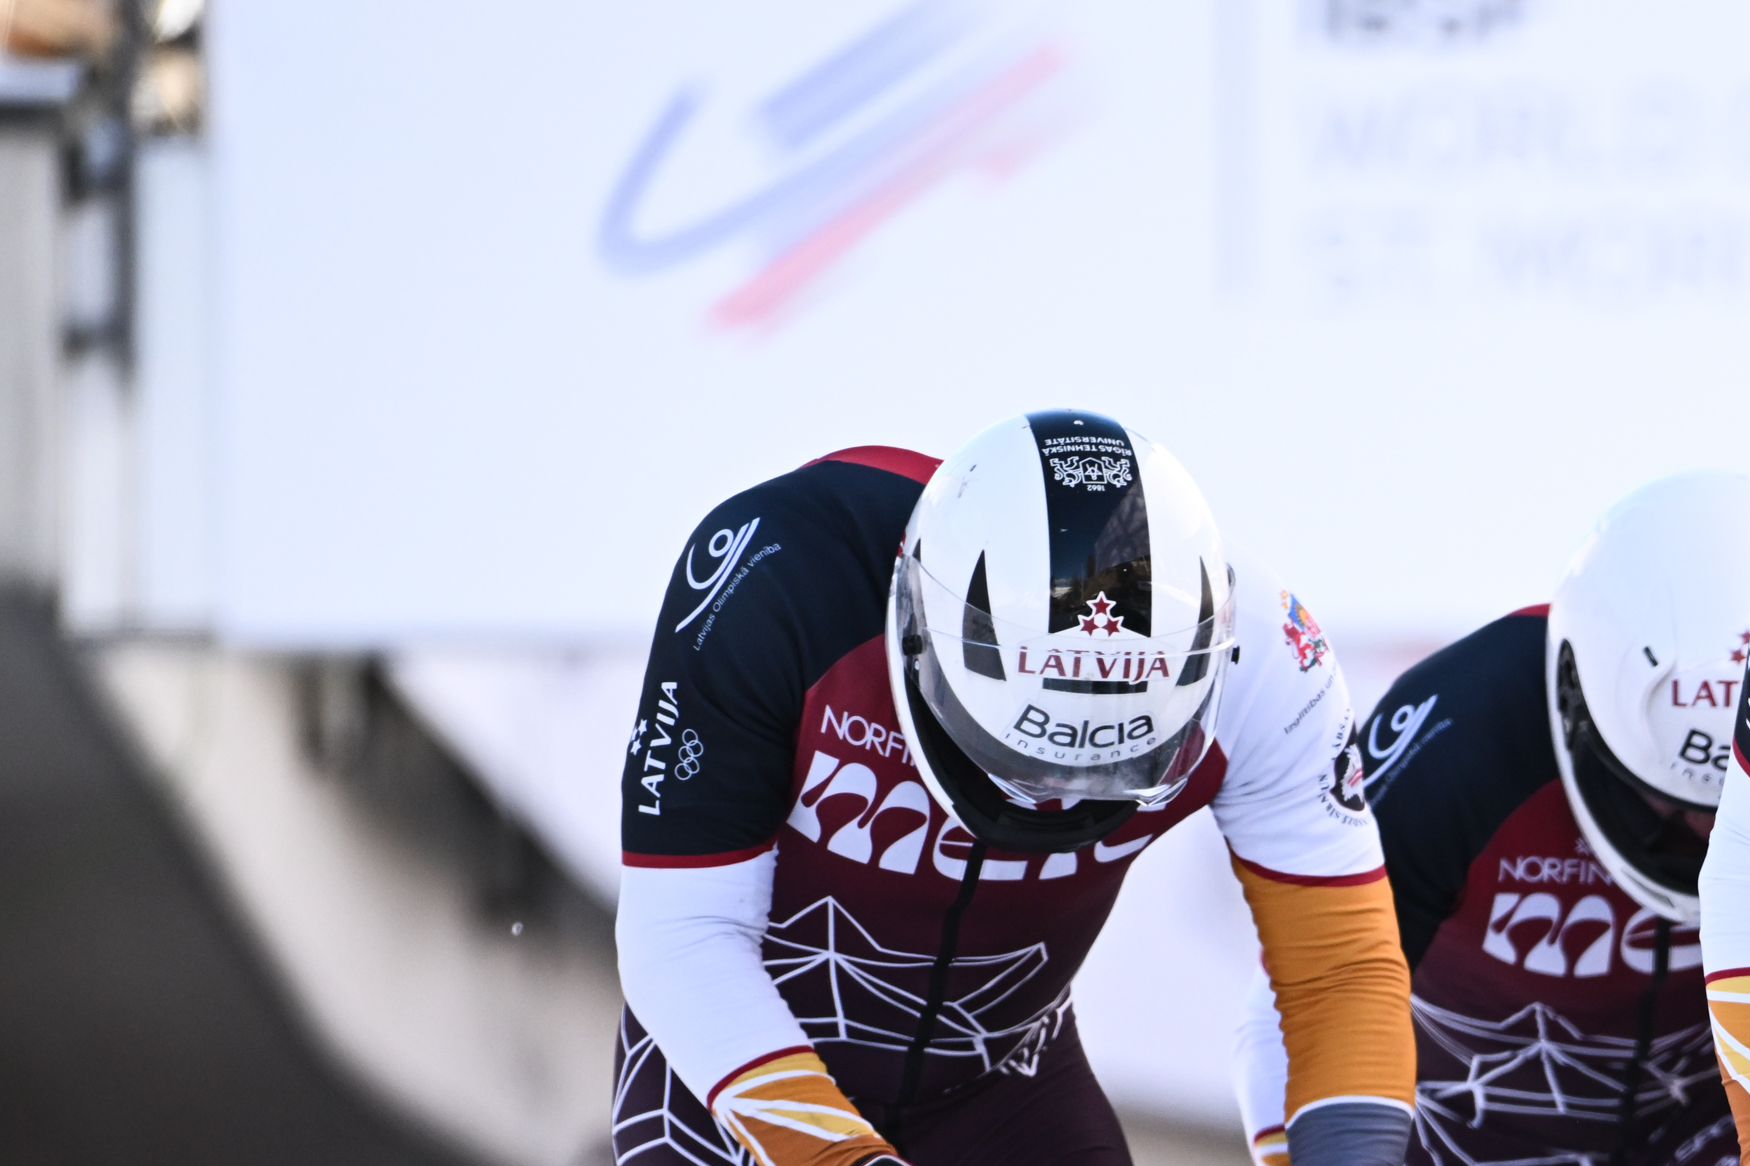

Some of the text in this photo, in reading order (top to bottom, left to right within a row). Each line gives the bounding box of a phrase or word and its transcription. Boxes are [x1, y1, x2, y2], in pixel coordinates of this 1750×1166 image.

[1017, 646, 1170, 685] LATVIJA
[638, 681, 678, 816] LATVIJA
[820, 704, 917, 767] NORFI
[1004, 732, 1157, 763] insurance
[1013, 704, 1155, 749] Balcia
